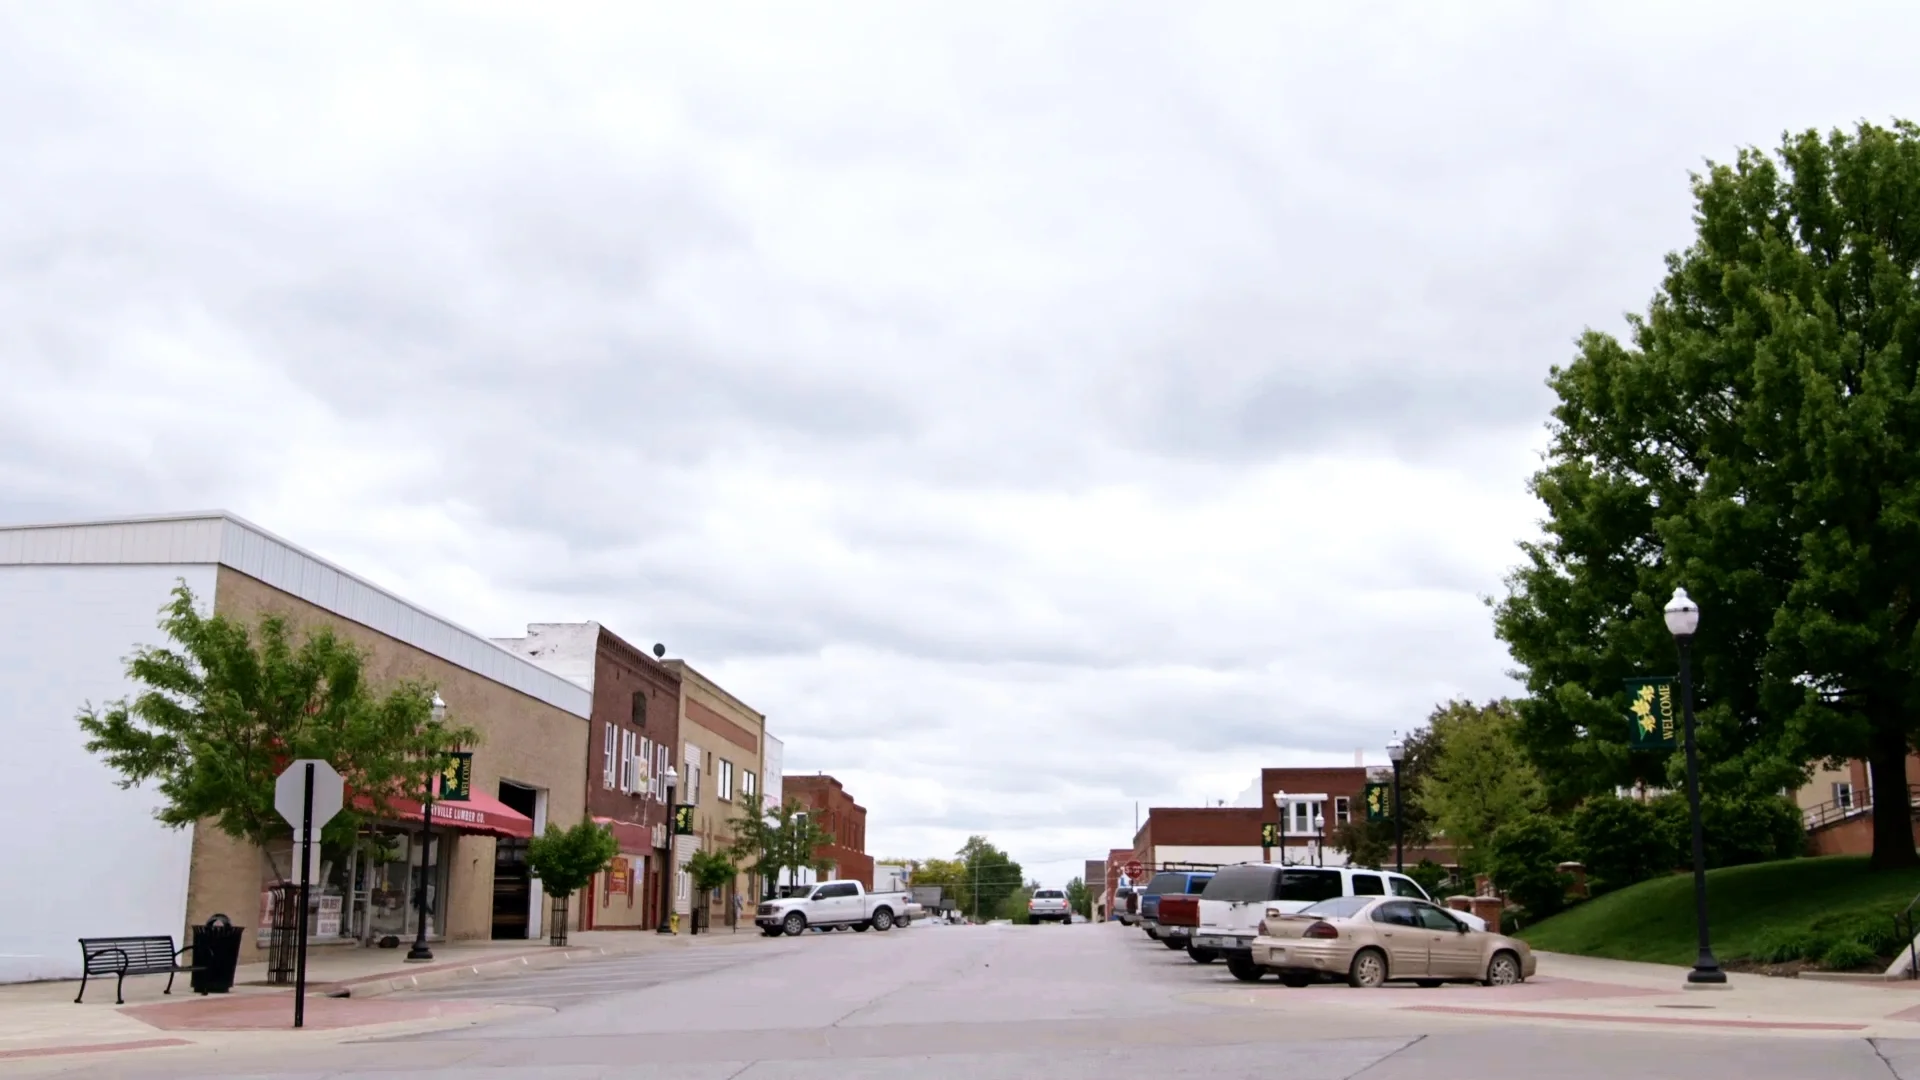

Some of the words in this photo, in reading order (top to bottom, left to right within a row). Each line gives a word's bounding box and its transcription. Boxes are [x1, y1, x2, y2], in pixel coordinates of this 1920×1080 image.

[1658, 684, 1674, 740] WELCOME
[461, 757, 471, 796] WELCOME
[454, 808, 476, 822] LUMBER
[1125, 865, 1143, 874] STOP
